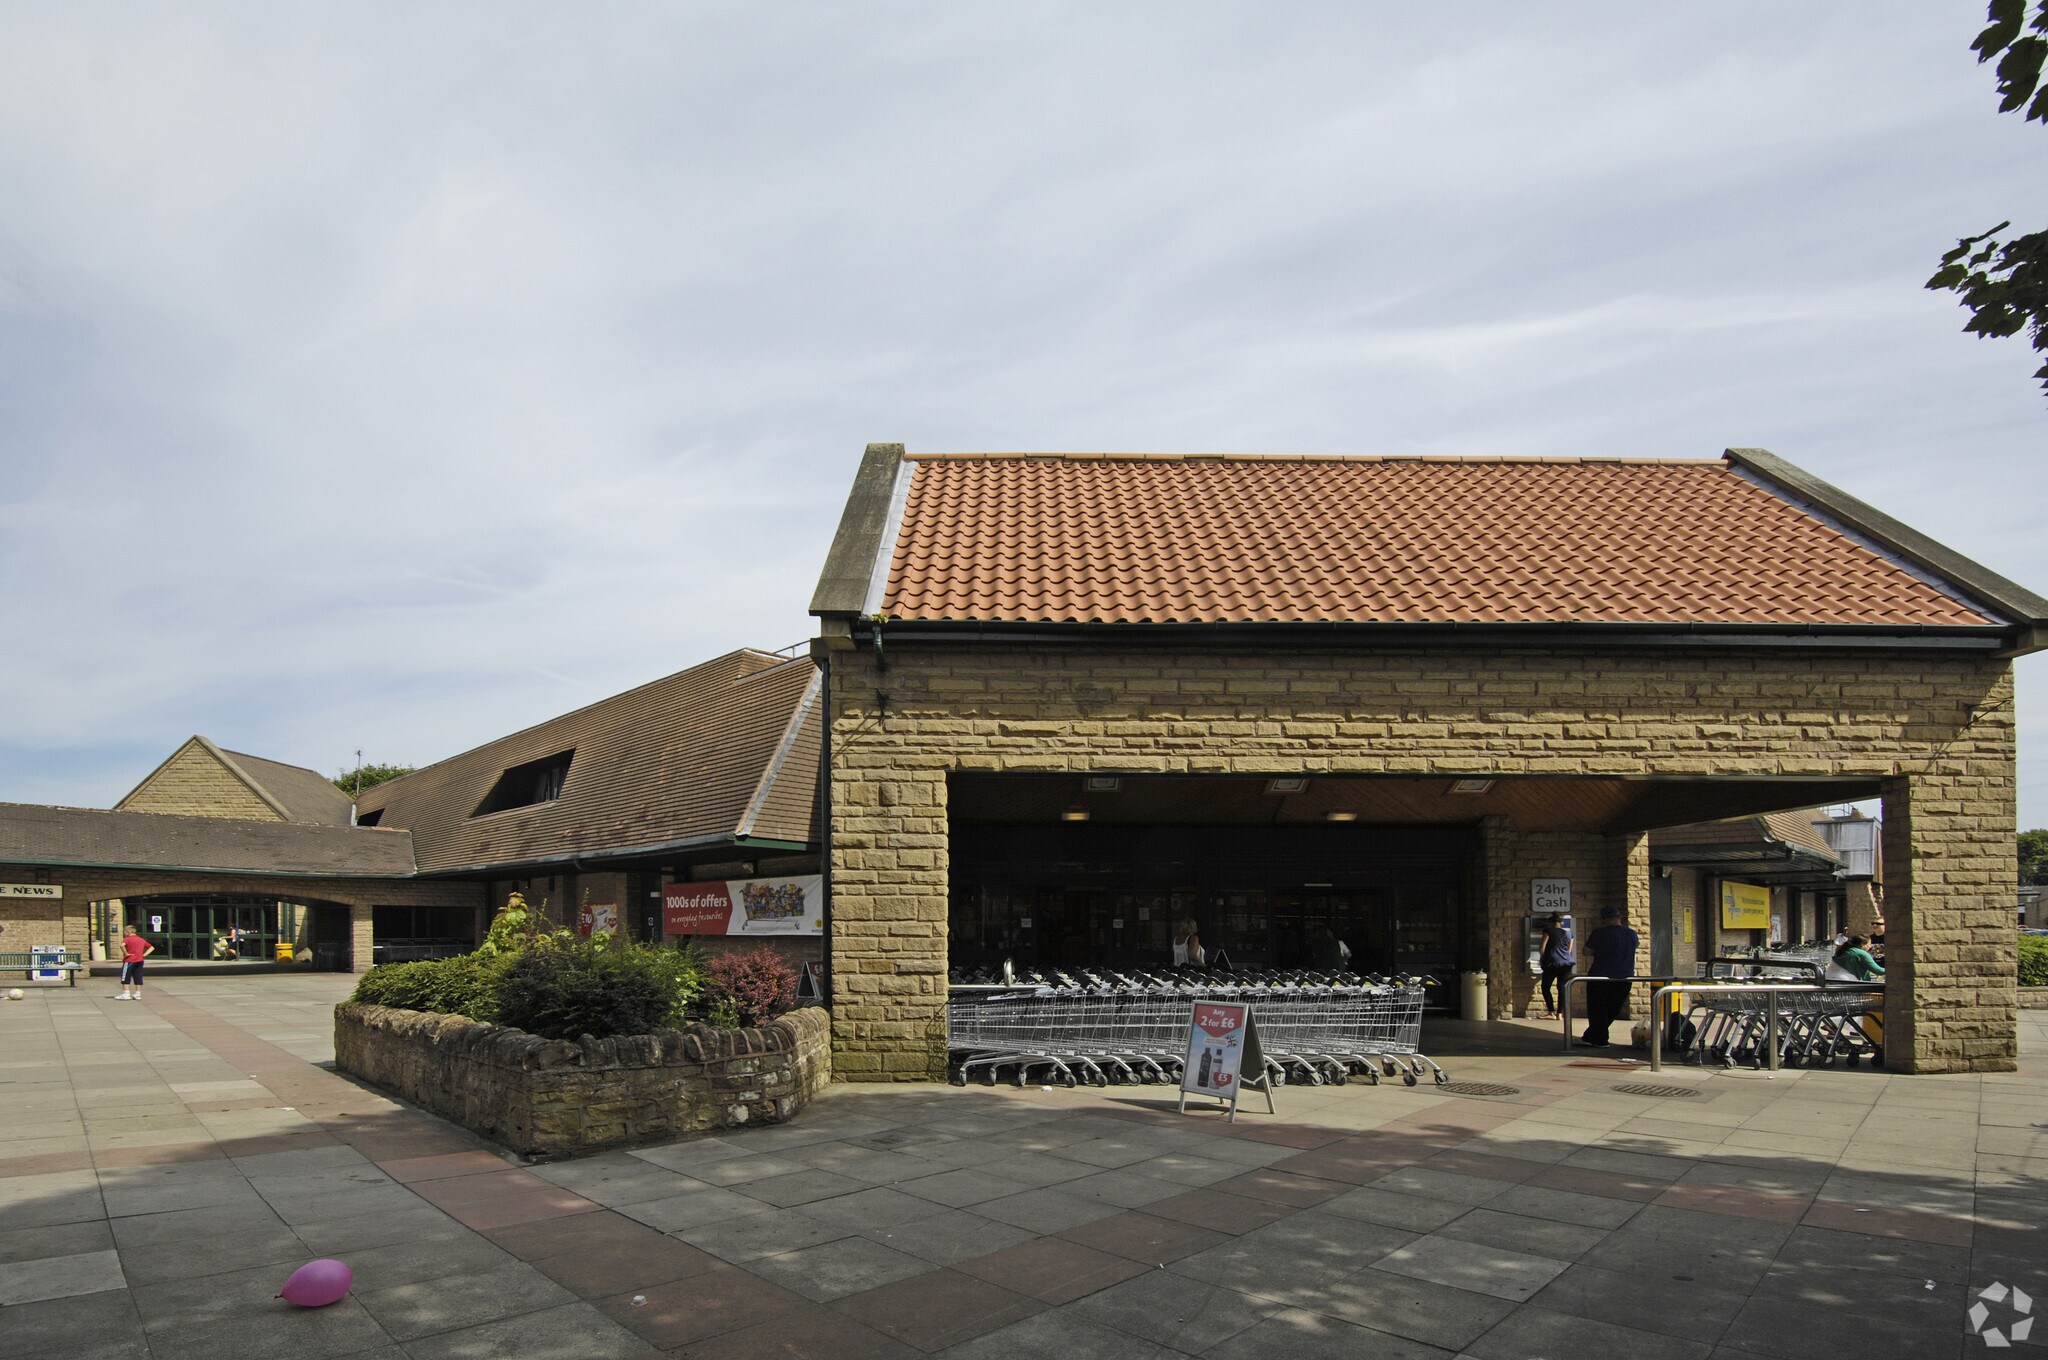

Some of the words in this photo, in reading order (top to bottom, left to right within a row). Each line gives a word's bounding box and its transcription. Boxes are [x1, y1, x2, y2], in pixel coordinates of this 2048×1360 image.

[13, 886, 54, 894] NEWS
[1536, 884, 1567, 894] 24hr
[666, 896, 689, 909] 1000s
[690, 894, 700, 908] of
[700, 894, 728, 908] offers
[1536, 897, 1567, 907] Cash
[677, 914, 698, 927] everyday
[1201, 1016, 1208, 1026] 2
[1209, 1019, 1220, 1027] for
[1221, 1018, 1235, 1028] £6
[1218, 1074, 1228, 1082] £5
